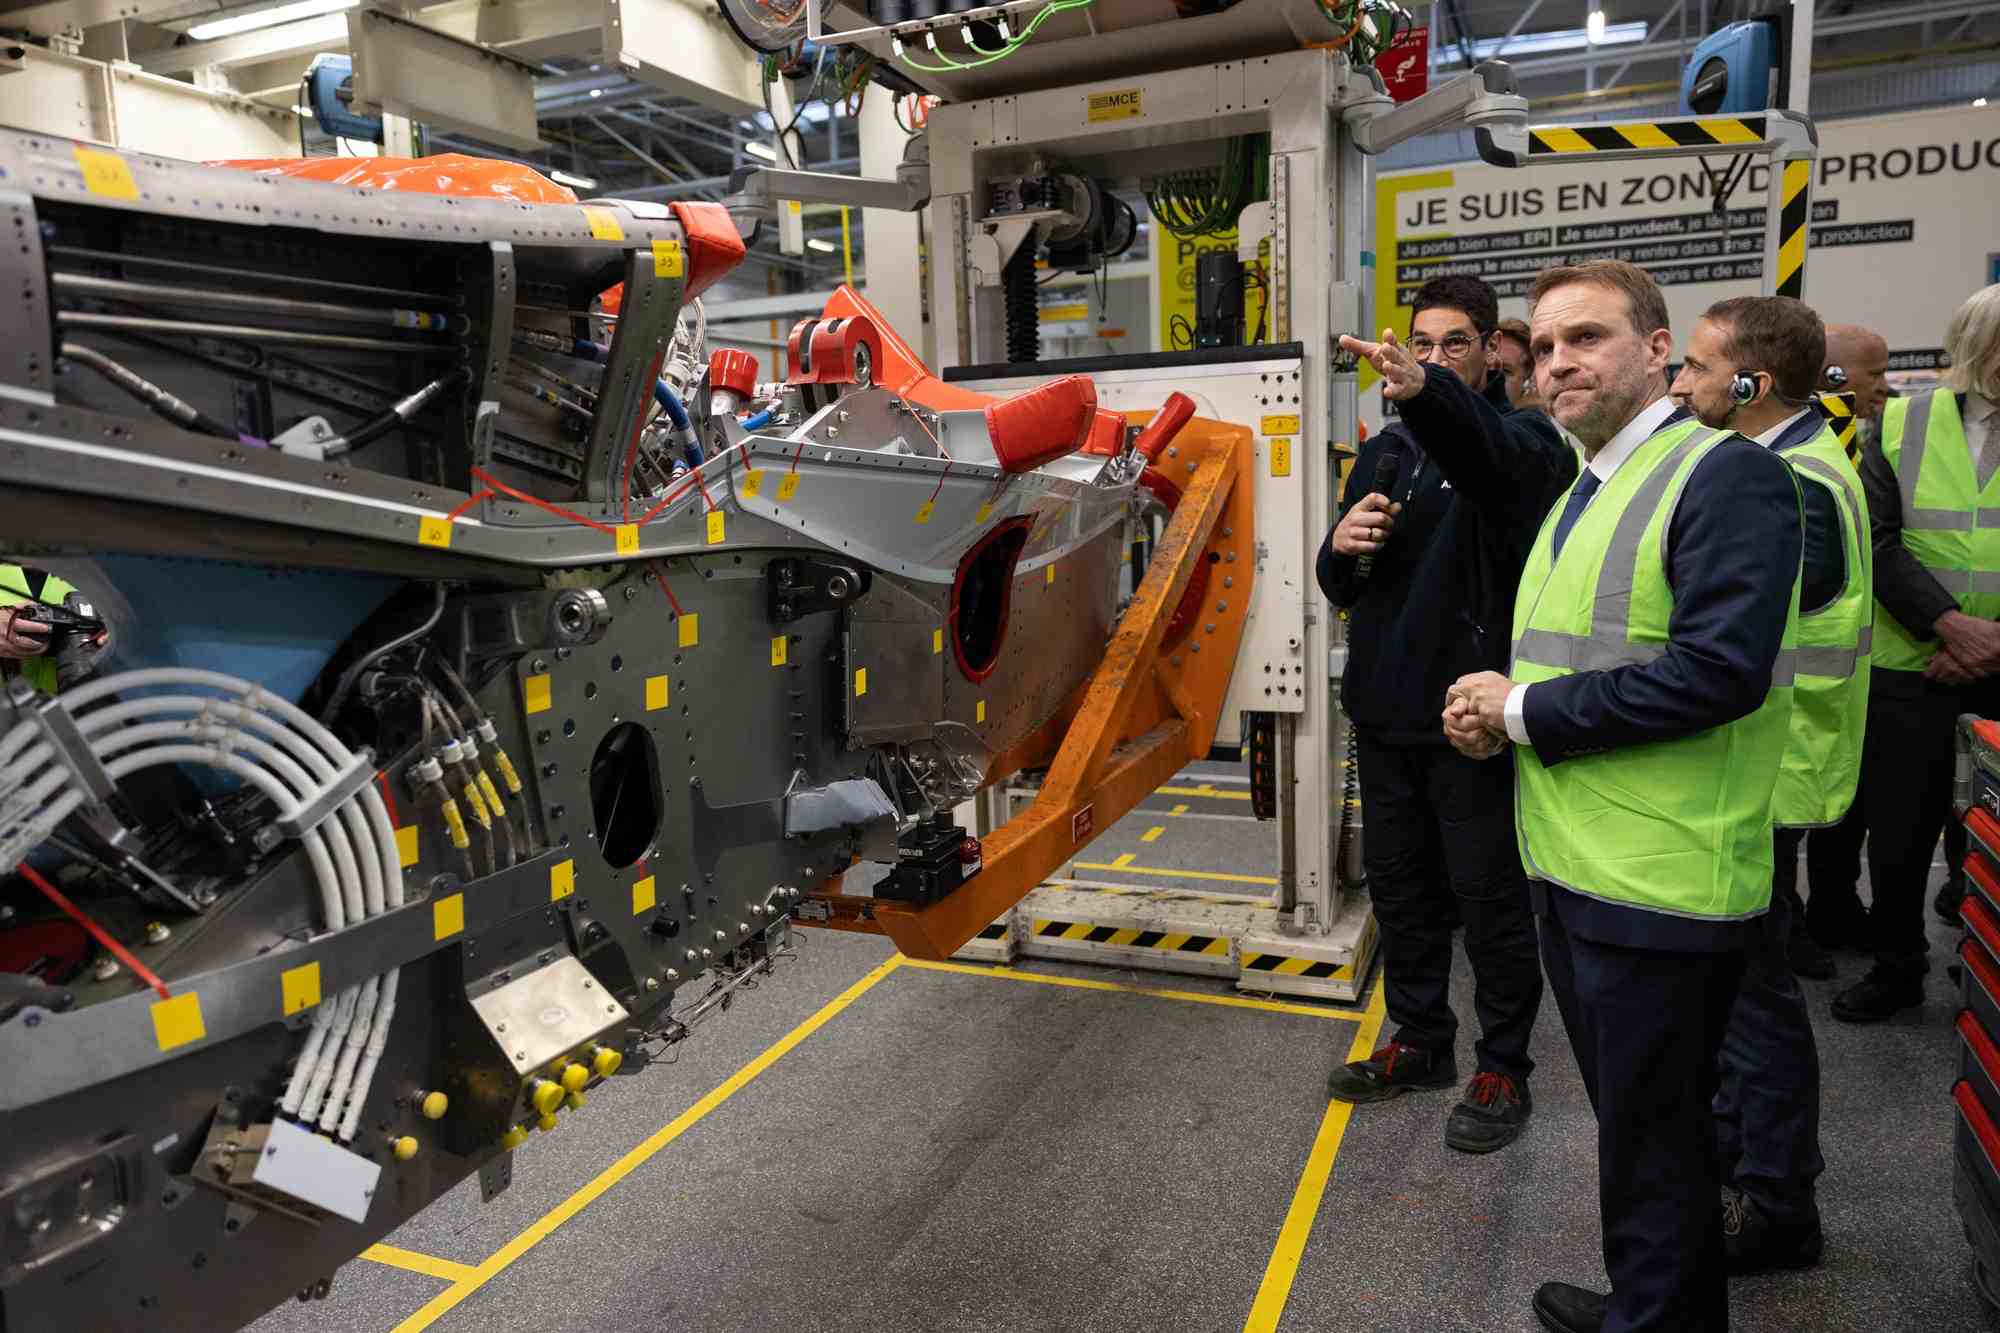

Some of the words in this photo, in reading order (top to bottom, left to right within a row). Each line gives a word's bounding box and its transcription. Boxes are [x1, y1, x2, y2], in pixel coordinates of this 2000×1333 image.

[1406, 198, 1448, 227] JE
[1459, 187, 1544, 222] SUIS
[1557, 180, 1607, 213] EN
[1562, 227, 1580, 241] Je
[1583, 223, 1616, 239] suis
[1618, 218, 1684, 240] prudent,
[1687, 217, 1703, 232] je
[1401, 246, 1419, 257] Je
[1421, 241, 1457, 256] porte
[1459, 238, 1488, 251] bien
[1524, 230, 1549, 244] EPI
[1401, 266, 1419, 279] Je
[1484, 259, 1498, 272] le
[1635, 244, 1679, 259] rentre
[1681, 239, 1719, 256] dans
[1822, 222, 1910, 246] production
[1693, 264, 1709, 279] et
[1712, 261, 1733, 277] de
